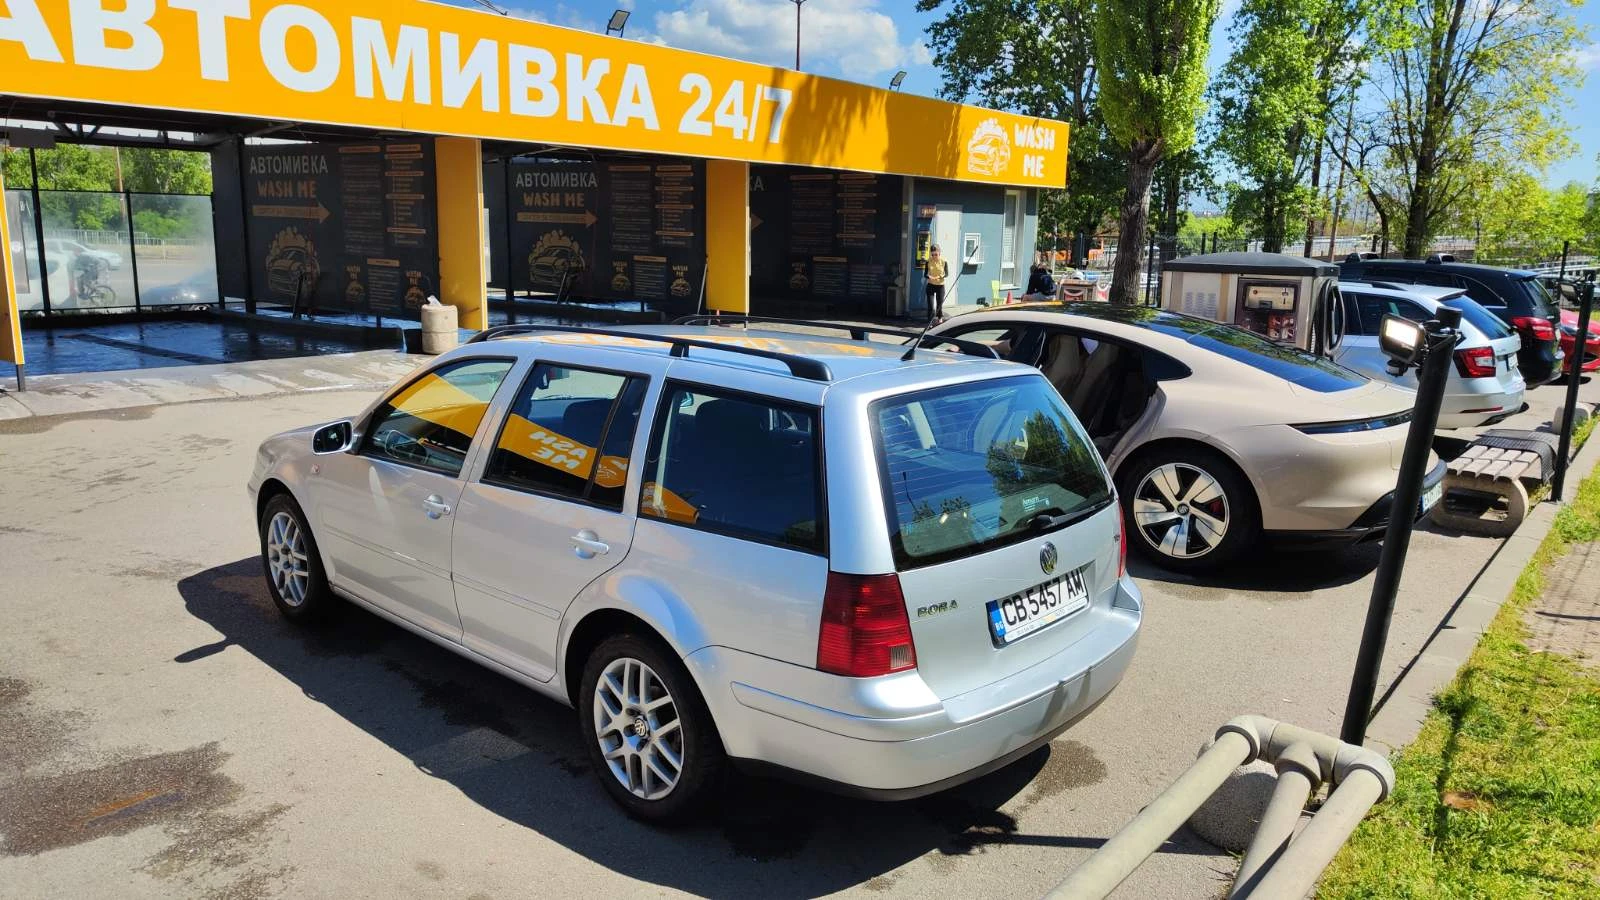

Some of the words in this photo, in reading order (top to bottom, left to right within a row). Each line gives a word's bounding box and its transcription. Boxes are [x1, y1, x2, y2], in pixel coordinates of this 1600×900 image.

[678, 72, 793, 144] 24/7
[1014, 123, 1056, 151] WASH
[249, 154, 329, 175] АВТОМИВКА
[1023, 154, 1046, 178] ME
[257, 180, 293, 198] WASH
[297, 180, 317, 199] ME
[515, 171, 599, 188] АВТОМИВКА
[523, 192, 560, 207] WASH
[564, 192, 585, 207] ME
[1002, 595, 1028, 626] CB
[1026, 576, 1061, 616] 5457
[1065, 567, 1085, 599] AM
[917, 599, 959, 618] BORA
